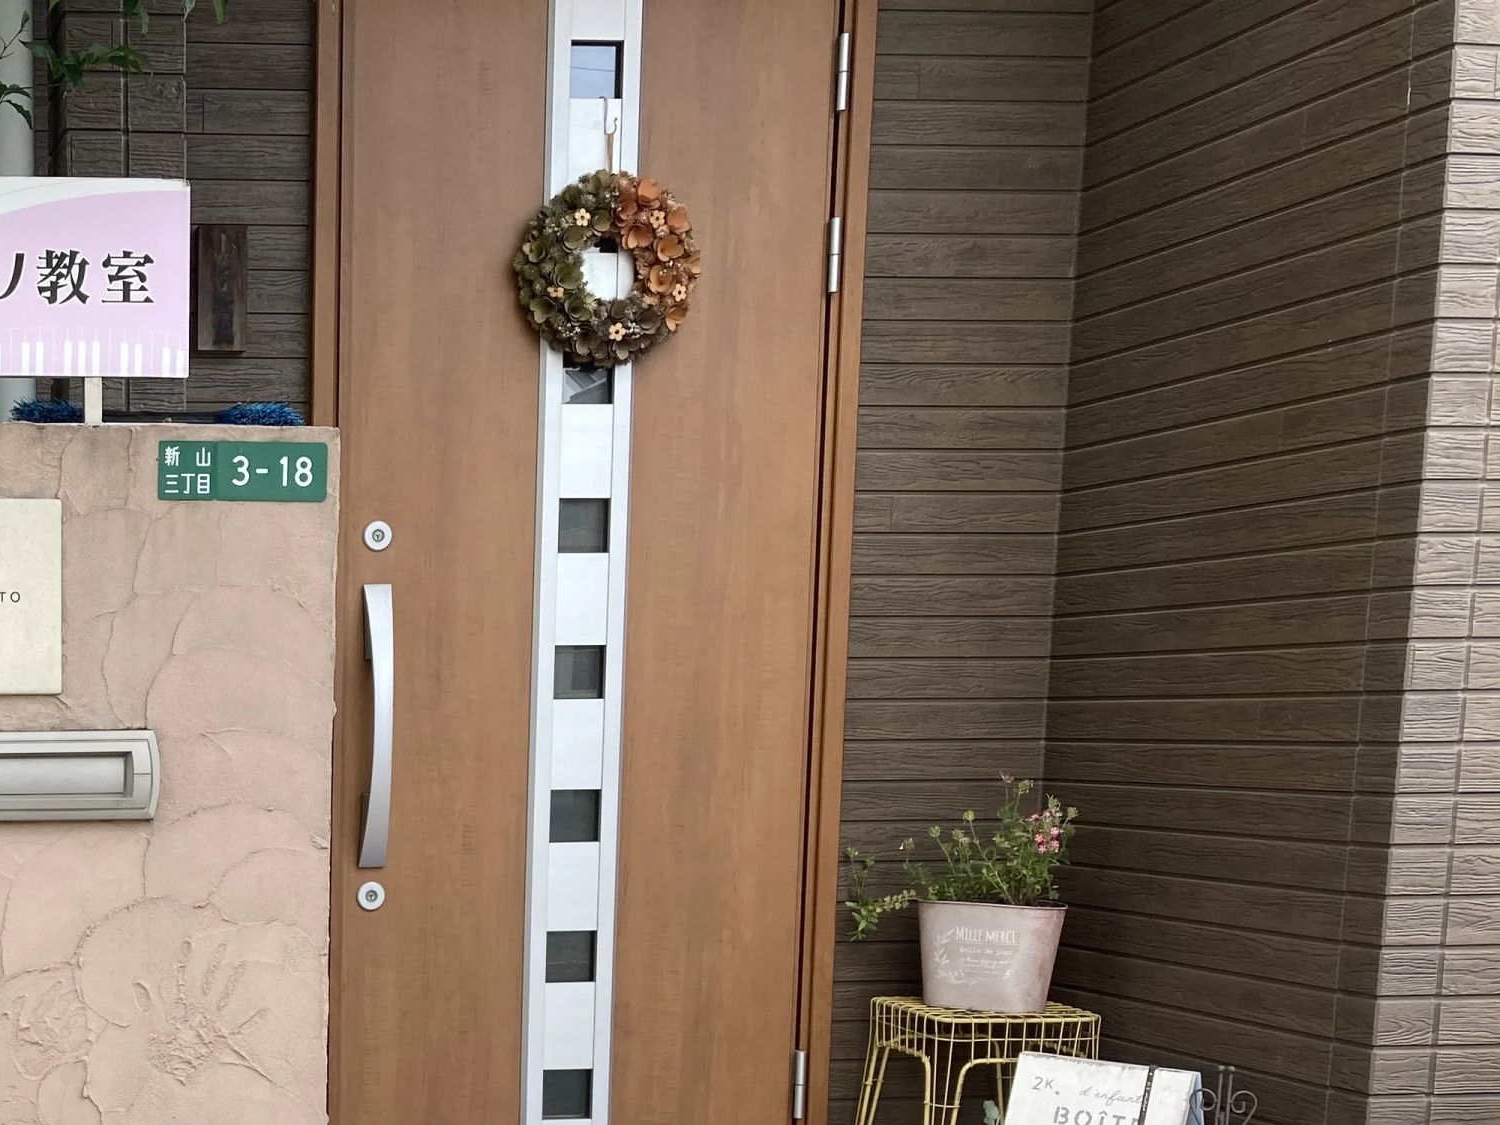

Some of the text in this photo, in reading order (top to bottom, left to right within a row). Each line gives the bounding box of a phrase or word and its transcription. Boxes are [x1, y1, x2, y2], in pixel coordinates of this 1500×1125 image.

[164, 446, 211, 467] 新山
[231, 455, 313, 487] 3-18
[164, 473, 211, 495] 三丁目
[985, 929, 1016, 945] MERCI
